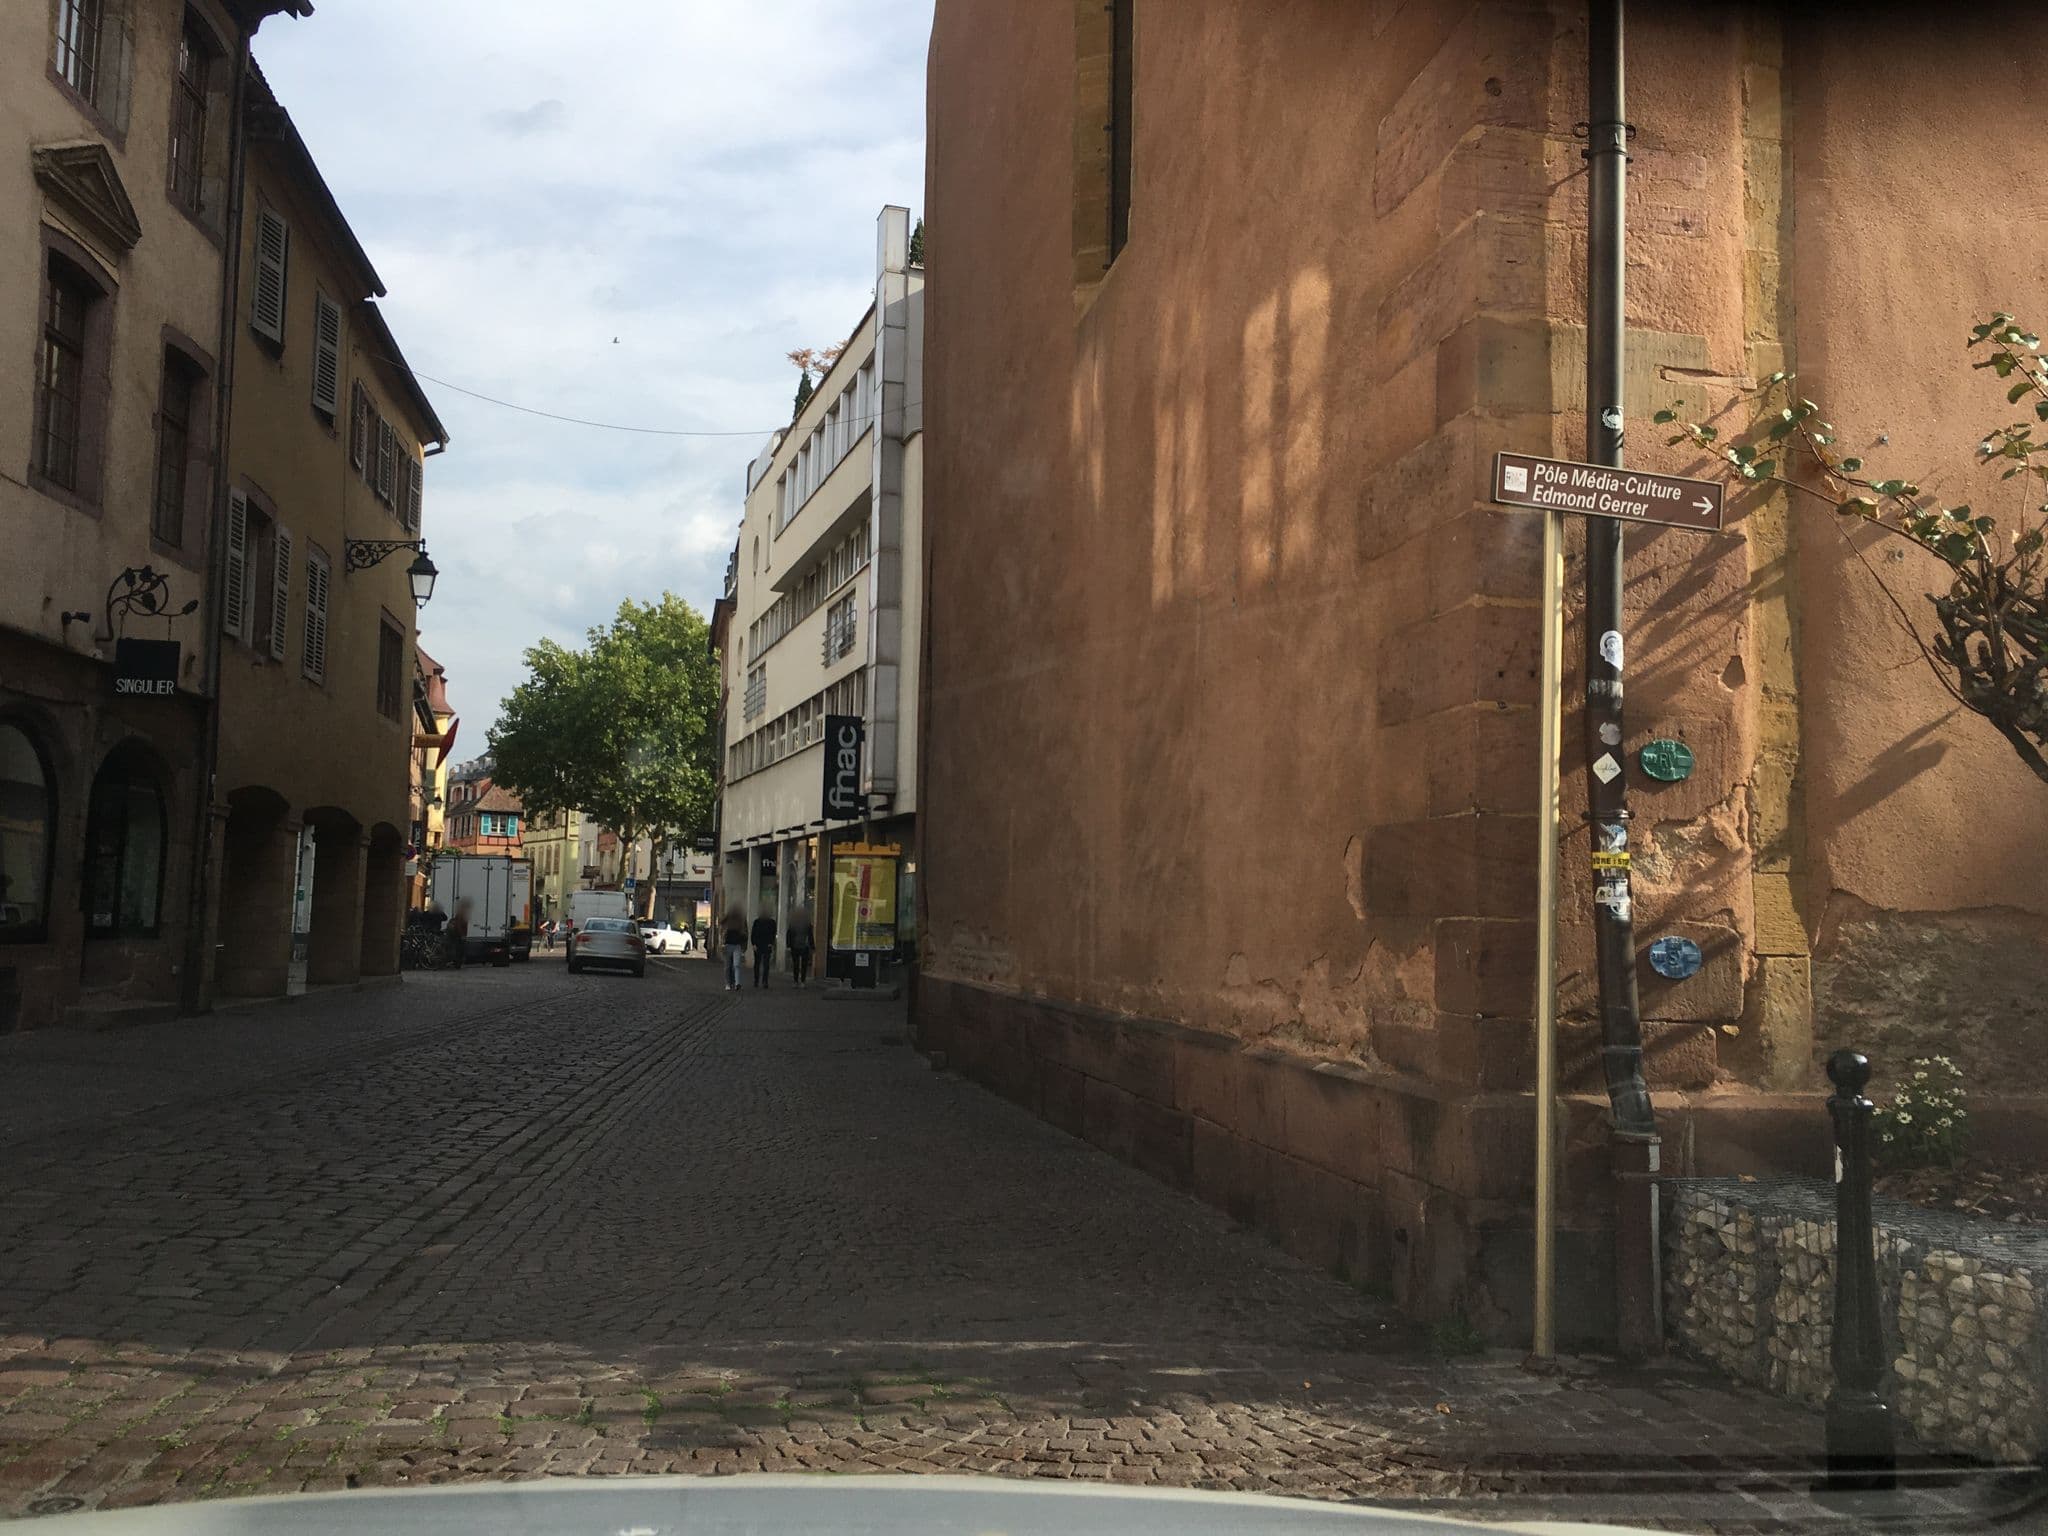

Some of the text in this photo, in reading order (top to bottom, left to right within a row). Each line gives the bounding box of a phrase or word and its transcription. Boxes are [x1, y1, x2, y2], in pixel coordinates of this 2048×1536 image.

[1533, 463, 1682, 501] Pôle Média-Culture
[1532, 484, 1649, 516] Edmond Gerrer
[116, 678, 174, 694] SINGULIER
[830, 726, 857, 809] fnac
